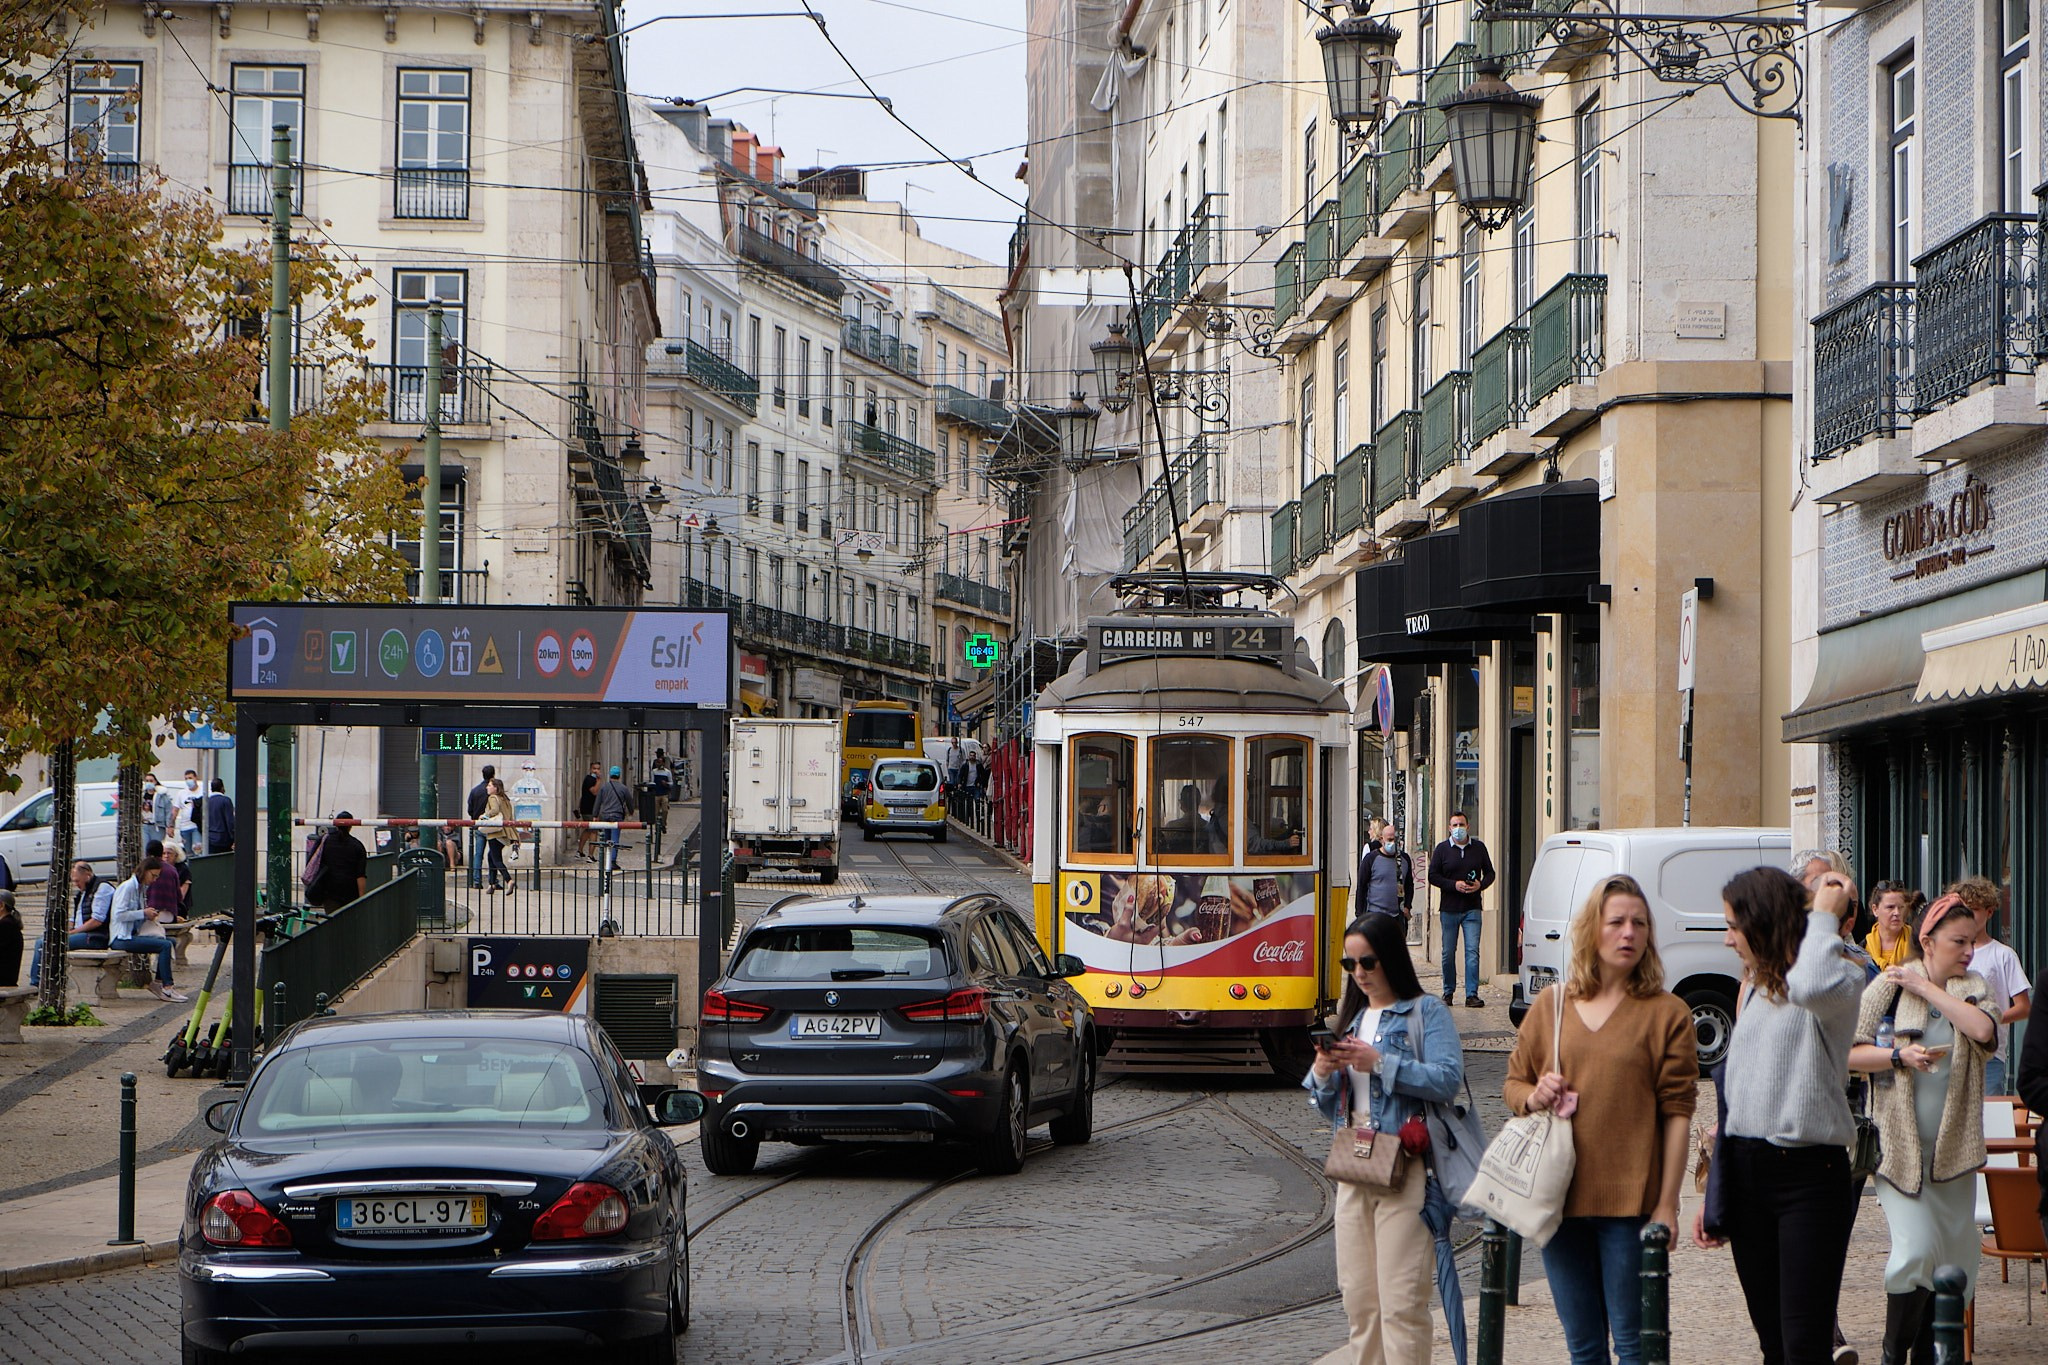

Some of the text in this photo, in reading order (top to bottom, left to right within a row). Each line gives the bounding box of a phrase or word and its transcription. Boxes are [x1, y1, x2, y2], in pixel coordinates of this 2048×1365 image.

[1102, 630, 1184, 648] CARREIRA
[1231, 628, 1266, 649] 24
[383, 644, 404, 661] 24h
[651, 635, 692, 668] Esli
[970, 646, 994, 656] 06:46
[2006, 637, 2017, 676] A
[259, 670, 278, 684] 24h
[655, 677, 689, 694] empark
[1178, 716, 1204, 727] 547
[440, 733, 502, 750] LIVRE
[1199, 902, 1231, 915] Coca-Cola
[1253, 940, 1306, 963] Coca-Cola
[480, 968, 495, 976] 24h
[803, 1017, 876, 1034] AG42PV
[471, 1200, 484, 1209] 06
[473, 1215, 484, 1223] 11
